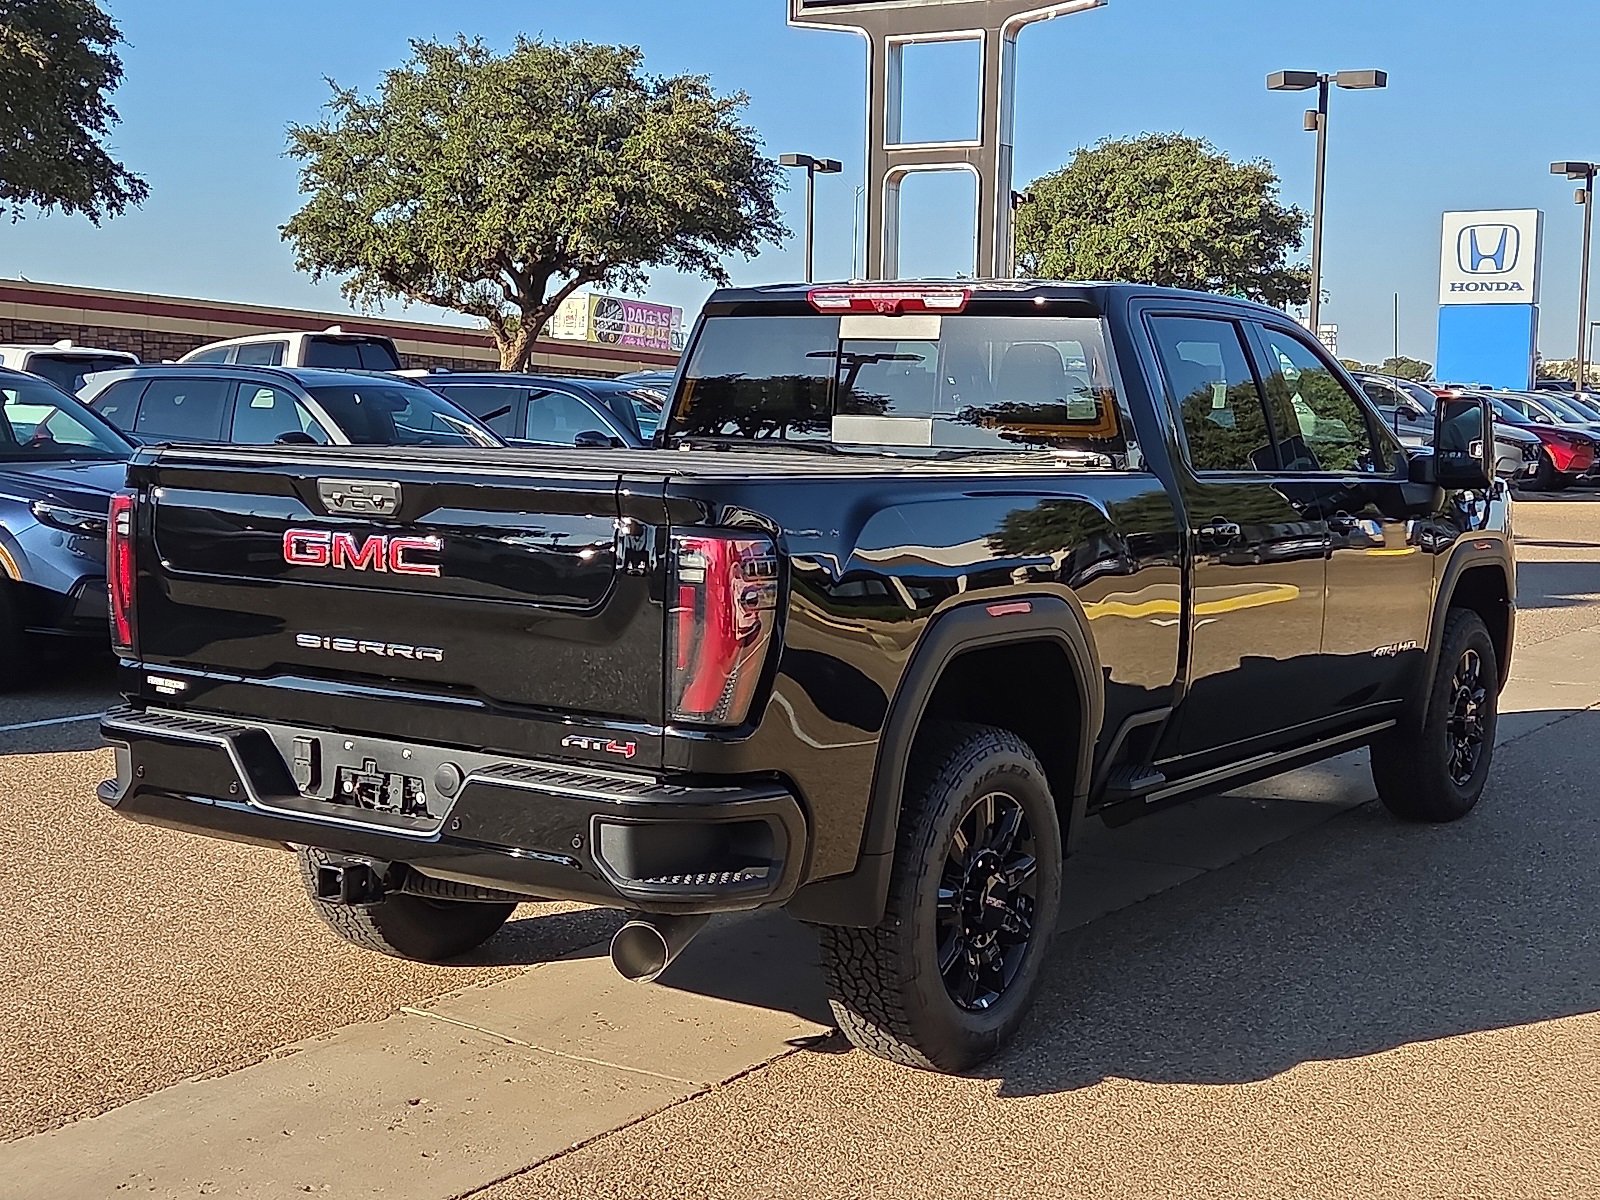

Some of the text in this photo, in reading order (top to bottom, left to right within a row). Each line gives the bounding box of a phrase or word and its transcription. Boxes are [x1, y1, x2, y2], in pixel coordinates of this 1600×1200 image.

[1449, 281, 1525, 293] HONDA
[283, 528, 444, 578] GMC
[295, 633, 445, 662] SIERRA
[561, 734, 637, 759] AT4
